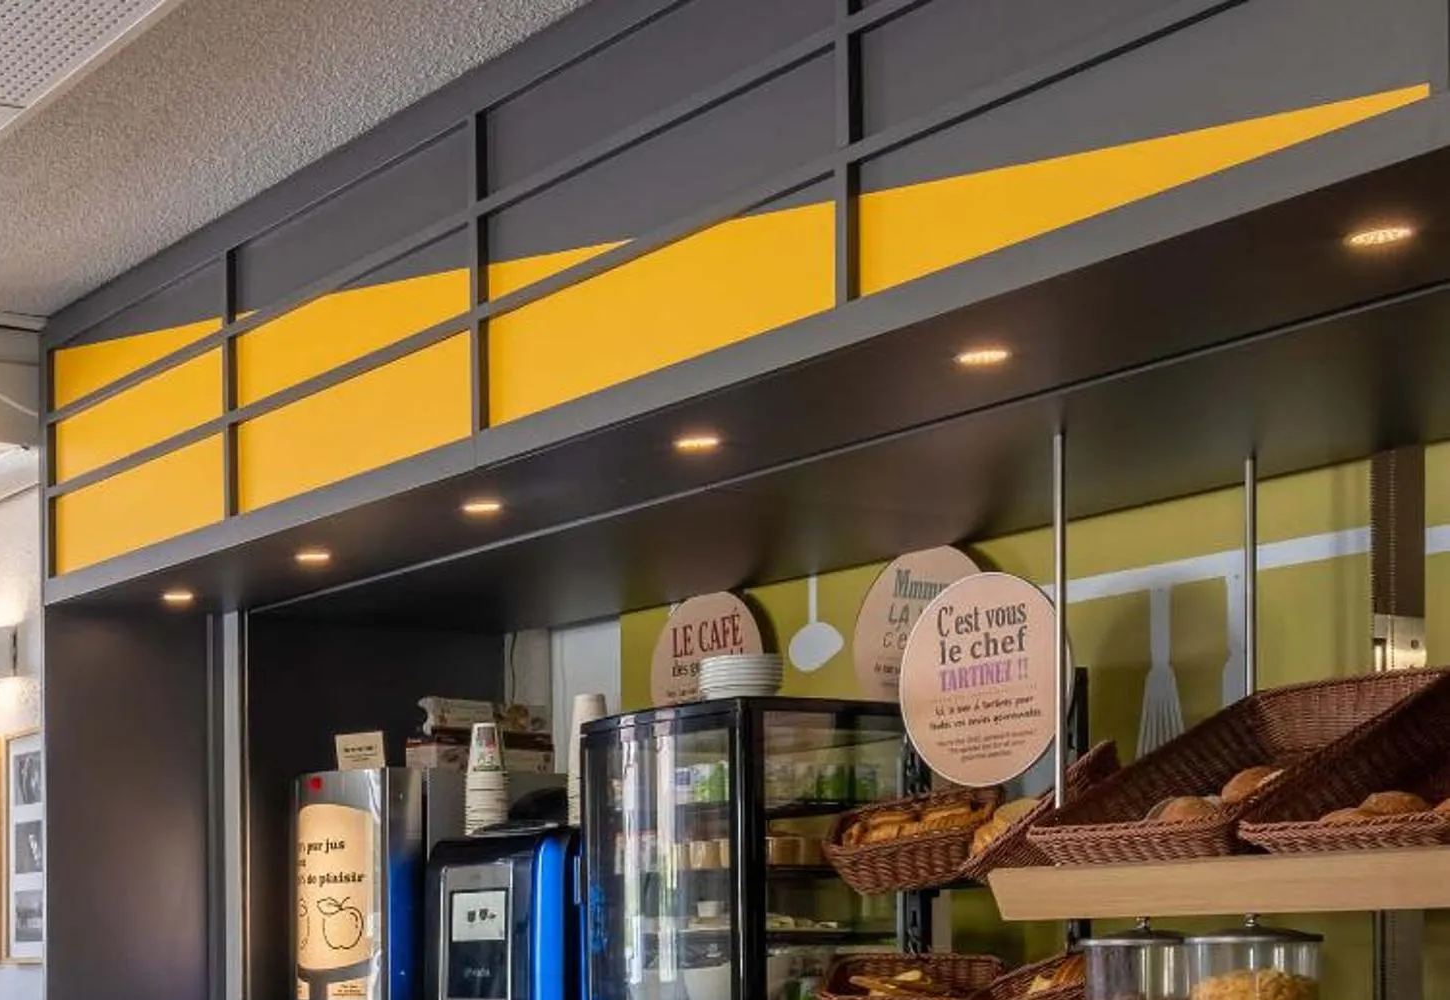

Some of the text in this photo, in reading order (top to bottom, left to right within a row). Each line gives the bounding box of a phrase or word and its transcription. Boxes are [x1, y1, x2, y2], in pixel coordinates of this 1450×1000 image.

[672, 604, 743, 658] LE CAFÉ
[936, 602, 1027, 638] C'est vous
[939, 625, 1028, 665] le chef
[939, 660, 1012, 693] TARTINEZ
[325, 838, 345, 854] jus
[319, 872, 366, 887] plaisir
